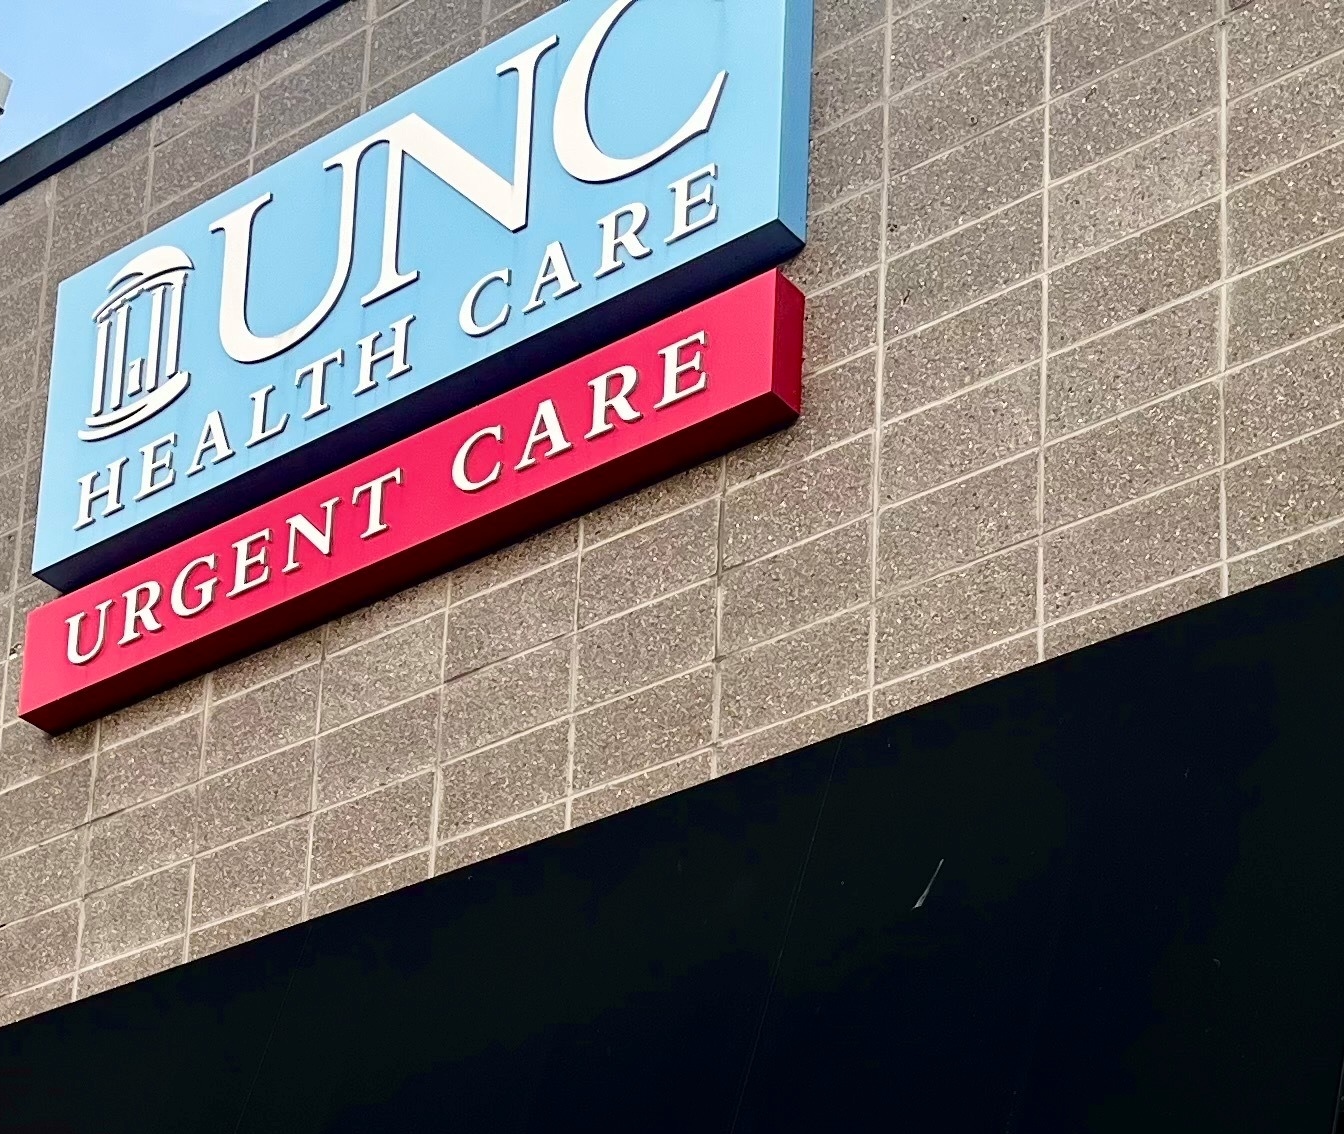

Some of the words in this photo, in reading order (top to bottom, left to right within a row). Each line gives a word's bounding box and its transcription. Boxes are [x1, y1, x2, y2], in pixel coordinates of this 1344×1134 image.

[73, 314, 418, 532] HEALTH
[459, 163, 720, 339] CARE
[209, 0, 728, 365] UNC
[64, 467, 404, 665] URGENT
[450, 330, 710, 492] CARE
